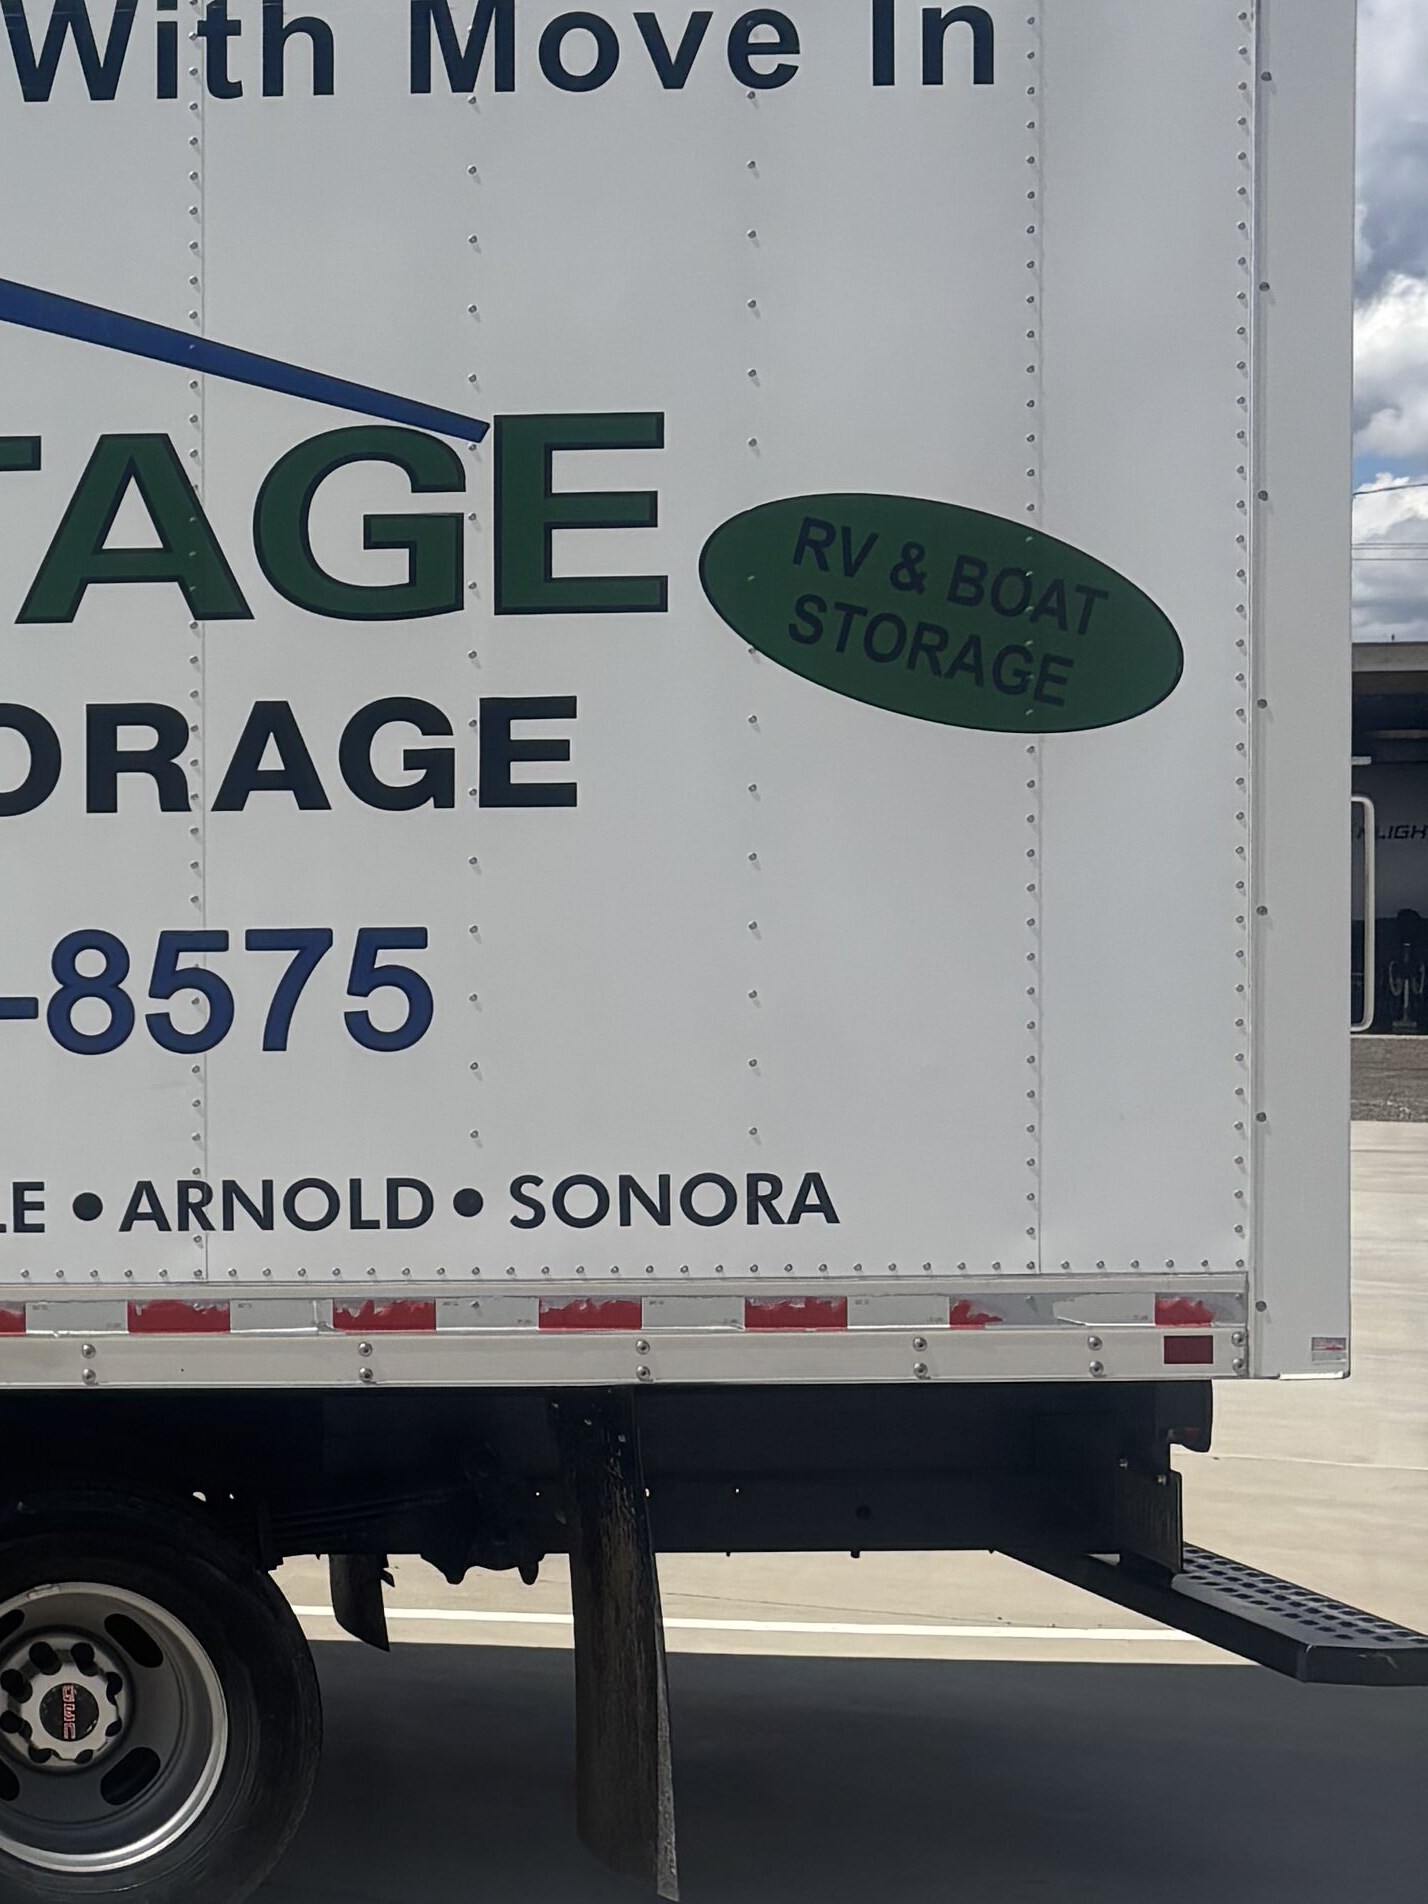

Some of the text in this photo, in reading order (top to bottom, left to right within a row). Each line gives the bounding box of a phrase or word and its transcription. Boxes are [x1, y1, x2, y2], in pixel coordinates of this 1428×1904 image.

[792, 516, 1109, 635] RV & BOAT
[788, 594, 1074, 707] STORAGE
[119, 1178, 433, 1232] ARNOLD
[510, 1173, 840, 1229] SONORA
